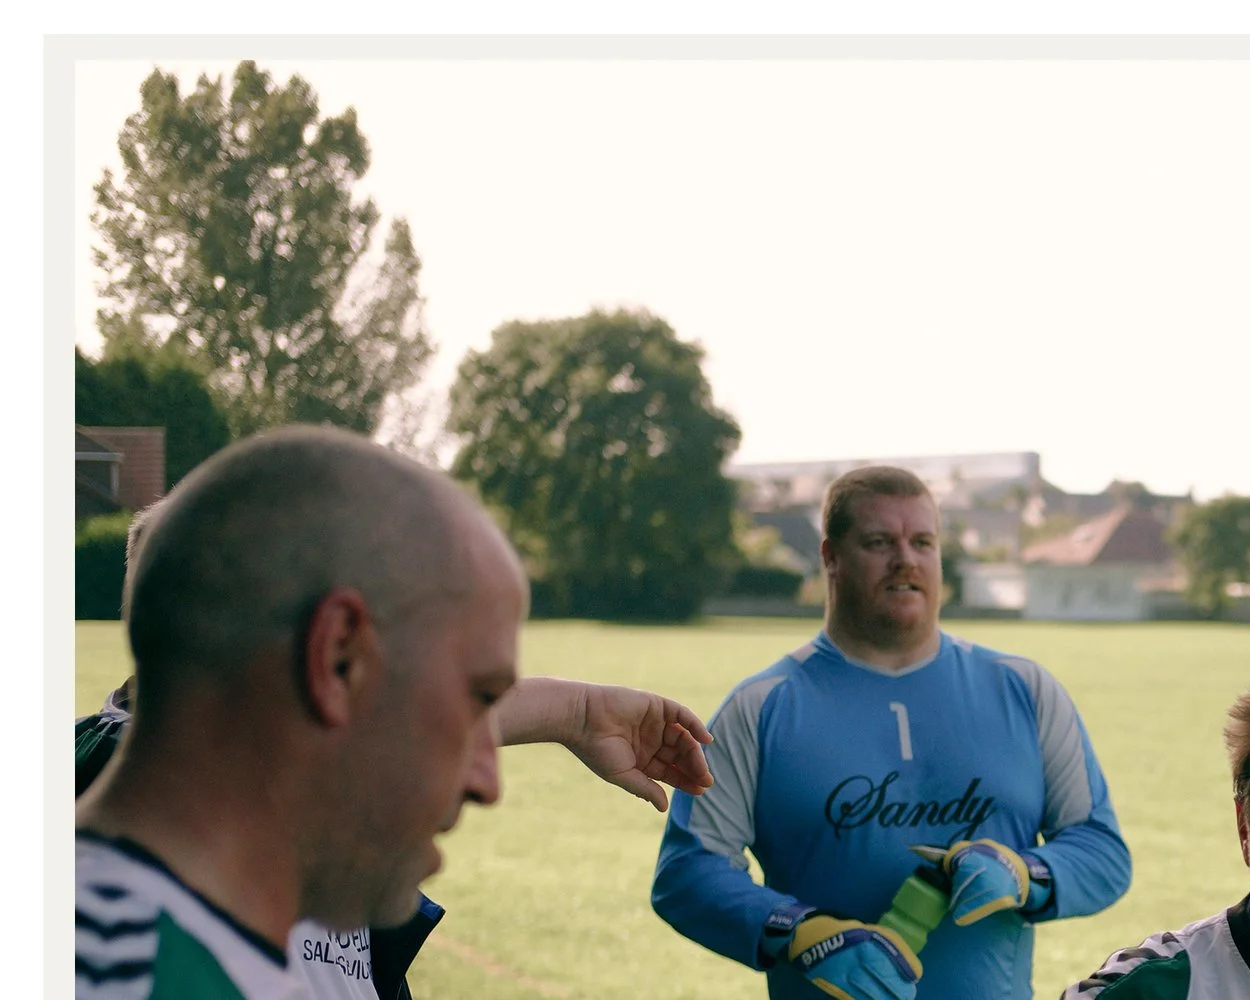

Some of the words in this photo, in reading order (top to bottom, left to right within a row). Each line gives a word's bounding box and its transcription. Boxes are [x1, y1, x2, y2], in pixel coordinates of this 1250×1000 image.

[889, 701, 913, 761] 1
[825, 770, 998, 849] Sandy
[801, 933, 845, 966] mitre
